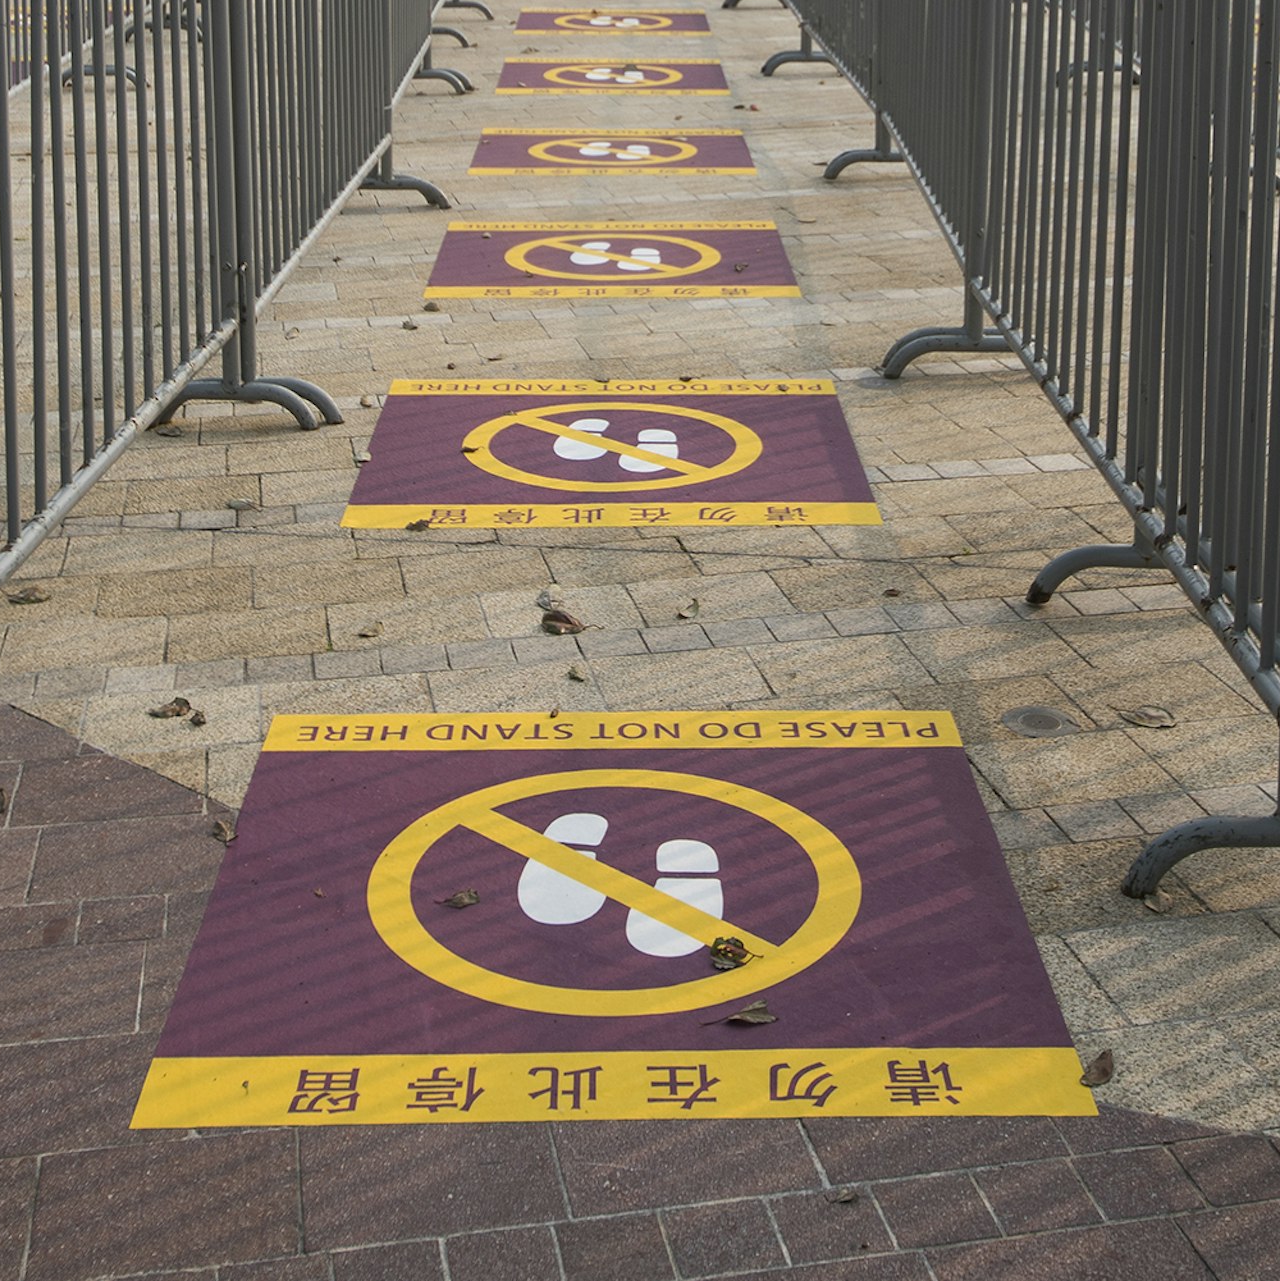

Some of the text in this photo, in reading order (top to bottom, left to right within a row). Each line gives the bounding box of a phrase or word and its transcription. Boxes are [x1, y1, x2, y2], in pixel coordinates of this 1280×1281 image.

[597, 383, 656, 391] NOT
[667, 383, 709, 391] DO
[720, 383, 823, 391] PLASE
[427, 506, 809, 524] 请勿在此停留
[297, 721, 940, 741] PLEASE DO NOT STAND HERE
[287, 1060, 963, 1114] 请勿在此停留
